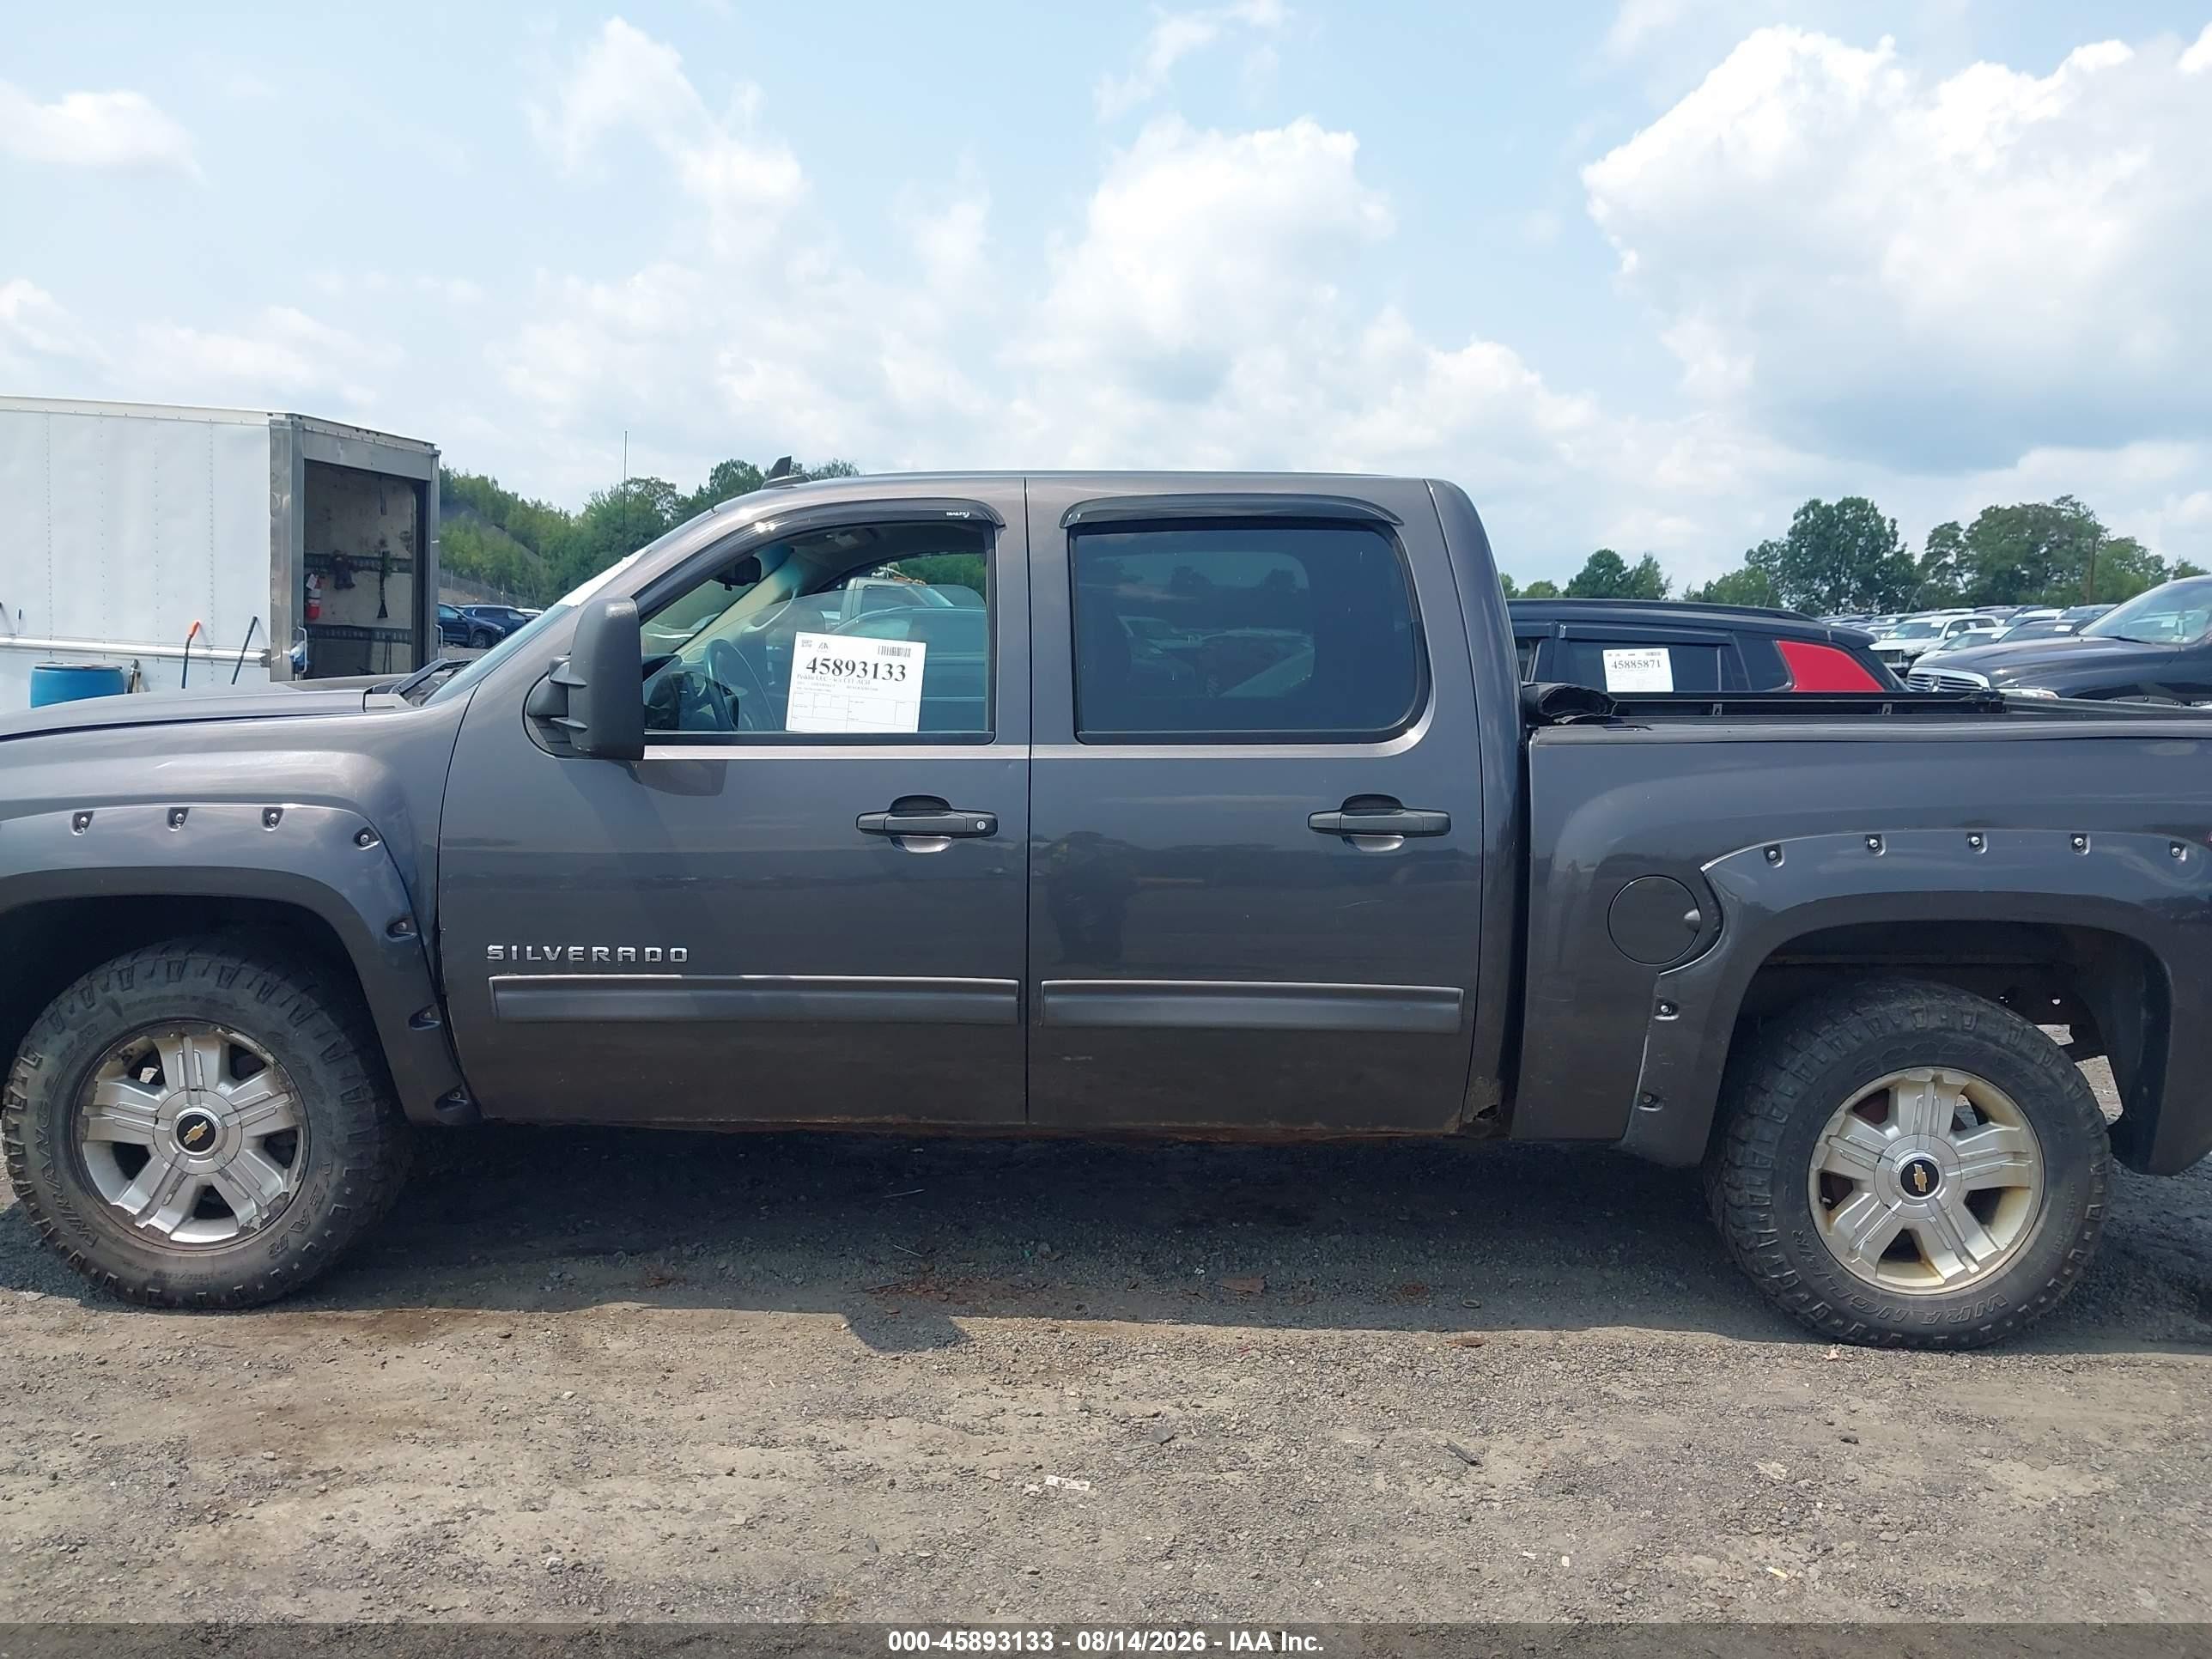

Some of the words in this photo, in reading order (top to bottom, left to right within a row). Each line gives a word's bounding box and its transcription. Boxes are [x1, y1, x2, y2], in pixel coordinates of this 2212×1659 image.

[805, 656, 906, 682] 45893133
[1612, 659, 1661, 669] 45885871
[487, 945, 688, 963] SILVERADO
